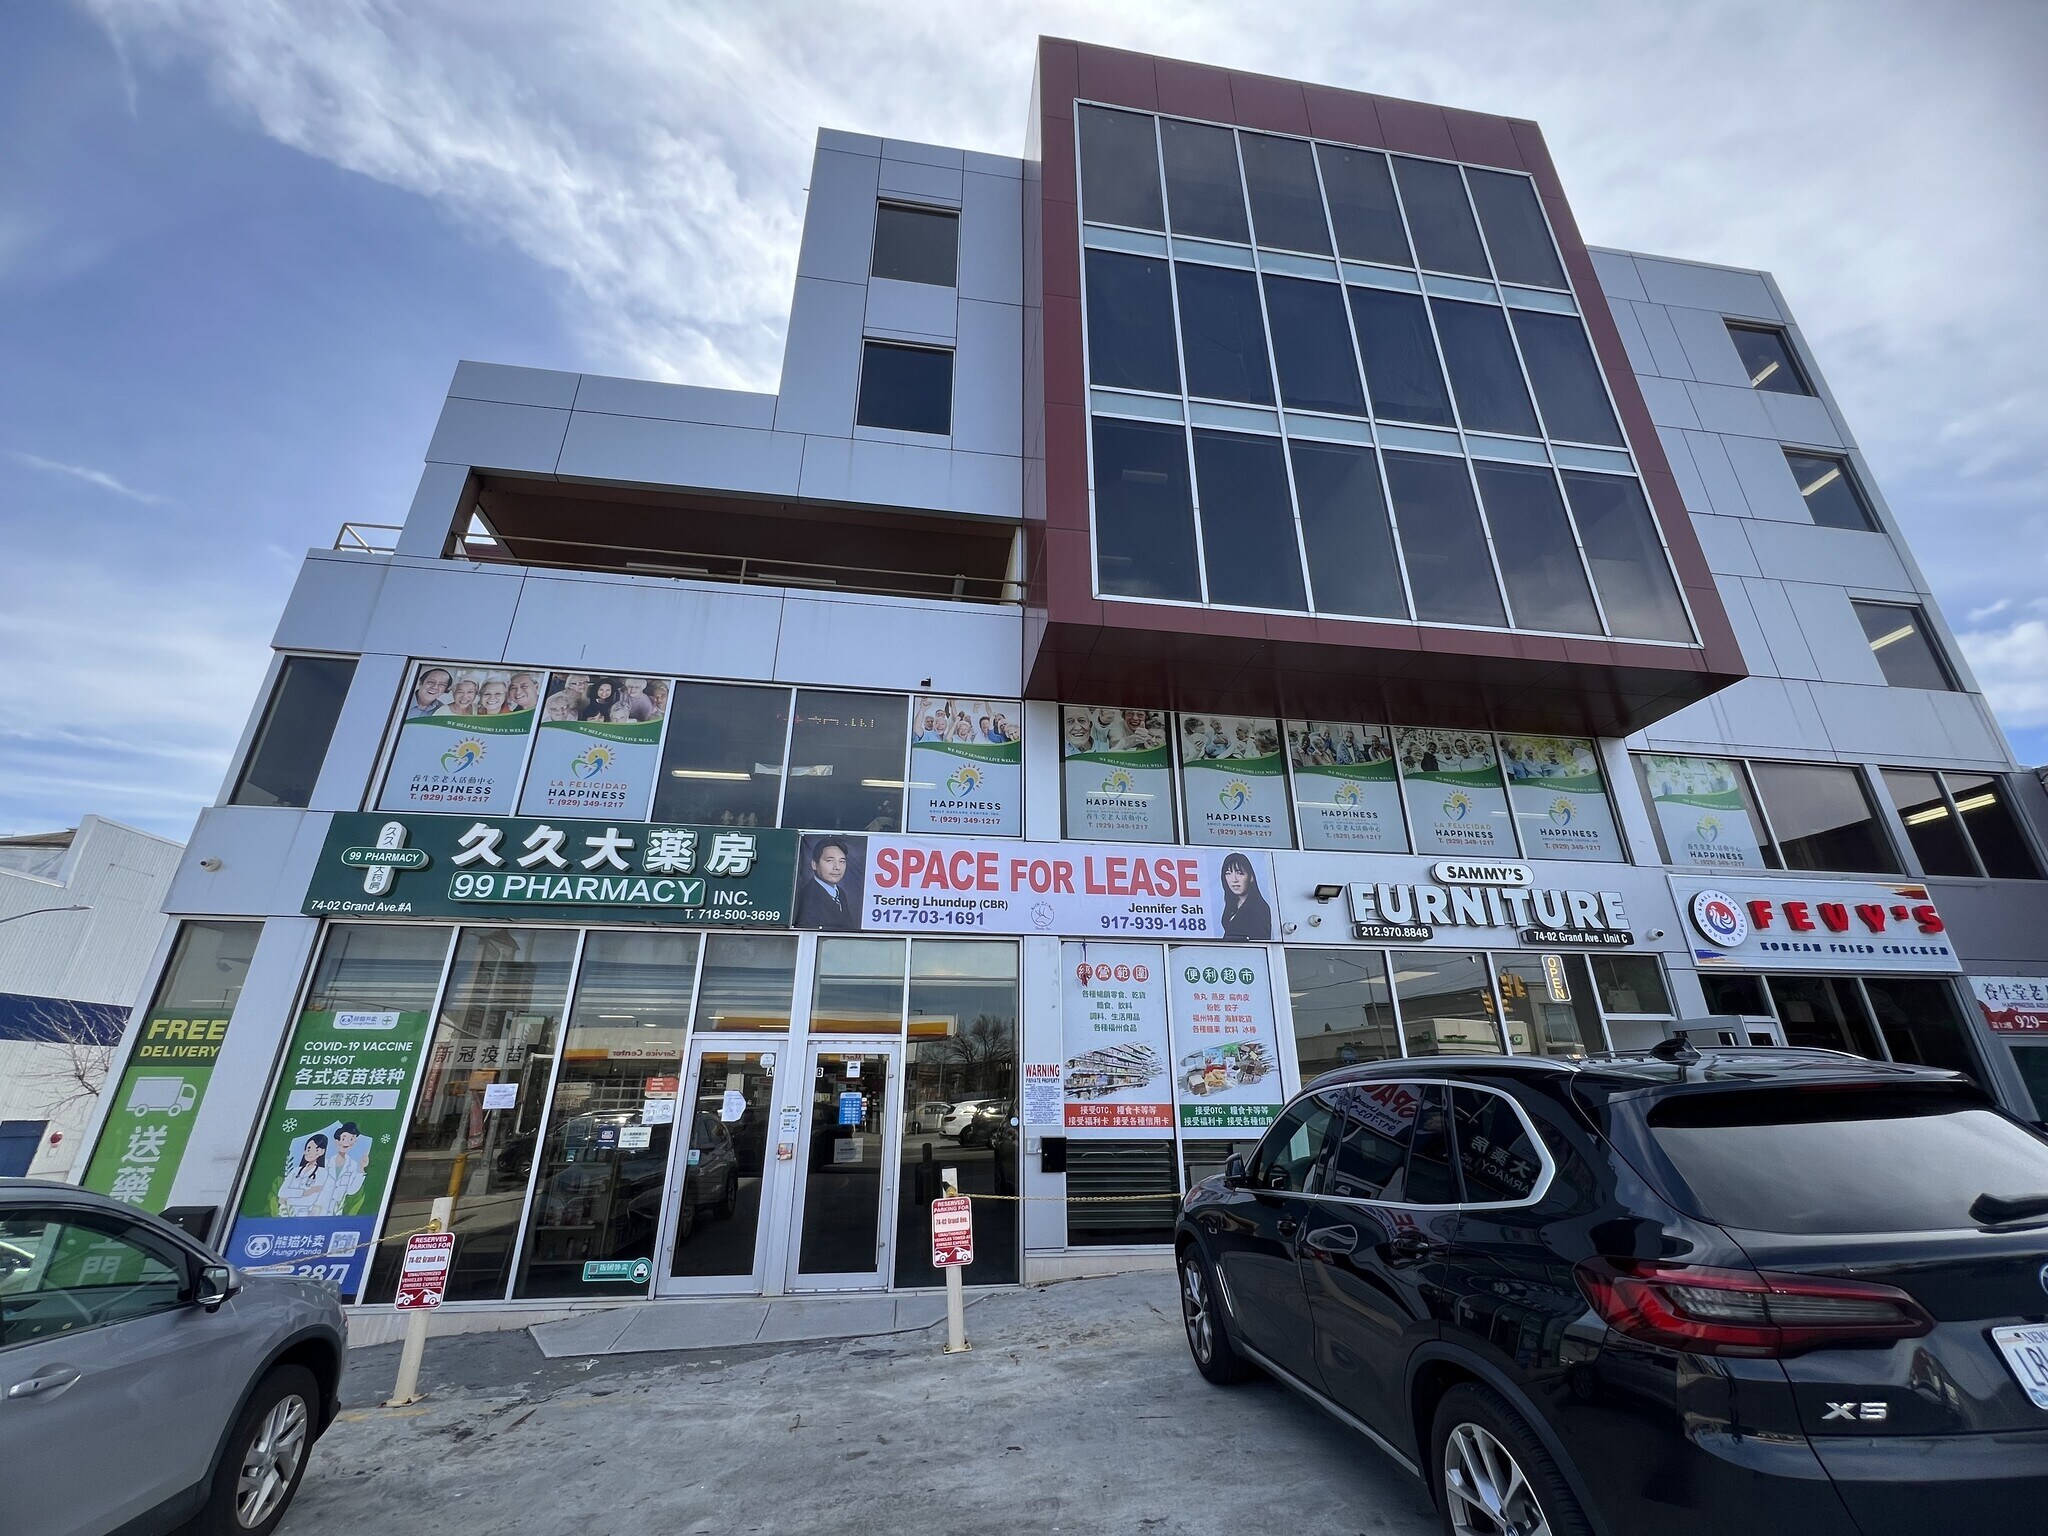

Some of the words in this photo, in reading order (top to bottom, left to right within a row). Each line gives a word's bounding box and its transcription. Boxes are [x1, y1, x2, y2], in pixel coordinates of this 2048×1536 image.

[410, 784, 492, 795] HAPPINESS
[569, 781, 627, 790] FELICIDAD
[447, 794, 490, 802] 349-1217
[548, 789, 626, 800] HAPPINESS
[558, 799, 580, 807] (929)
[583, 800, 624, 808] 349-1217
[930, 800, 1001, 811] HAPPINESS
[1086, 798, 1147, 808] HAPPINESS
[940, 816, 961, 824] (929)
[964, 817, 1000, 825] 349-1217
[1206, 813, 1271, 823] HAPPINESS
[1321, 810, 1378, 819] HAPPINESS
[1239, 829, 1272, 837] 349-1217
[1436, 829, 1494, 839] HAPPINESS
[1540, 829, 1598, 838] HAPPINESS
[451, 822, 757, 874] 久久大藥房
[349, 851, 362, 861] 99
[365, 852, 420, 863] PHARMACY
[1690, 851, 1743, 861] HAPPINESS
[874, 848, 1000, 892] SPACE
[1010, 859, 1075, 894] FOR
[1084, 856, 1200, 898] LEASE
[1446, 866, 1524, 881] SAMMY'S
[454, 874, 495, 898] 99
[502, 875, 701, 903] PHARMACY
[713, 890, 754, 906] INC.
[873, 895, 919, 909] Tsering
[923, 896, 977, 911] Lhundup
[979, 898, 1009, 911] (CBR)
[311, 900, 340, 911] 74-02
[342, 901, 375, 912] Grand
[375, 901, 413, 913] Ave.#A
[1128, 903, 1178, 915] Jennifer
[1180, 904, 1204, 915] Sah
[1347, 882, 1630, 929] FURNITURE
[684, 909, 694, 920] T.
[698, 909, 781, 921] 718-500-3699
[872, 908, 984, 926] 917-703-1691
[1100, 916, 1207, 931] 917-939-1488
[1361, 926, 1429, 937] 212.970.8848
[1534, 931, 1558, 941] 74-02
[1558, 932, 1583, 942] Grand
[1584, 933, 1602, 943] Ave.
[1603, 934, 1620, 943] Unit
[1621, 934, 1628, 944] C
[1760, 942, 1822, 952] KOREAN
[1830, 944, 1874, 953] FRIED
[1883, 945, 1949, 956] CHICKEN
[1186, 968, 1253, 982] 便利超市
[1547, 957, 1565, 999] OPEN
[1983, 983, 2048, 1000] 養生堂老
[147, 1019, 230, 1041] FREE
[139, 1045, 221, 1058] DELIVERY
[304, 1041, 361, 1051] COVID-19
[362, 1041, 414, 1051] VACCINE
[299, 1055, 322, 1065] FLU
[323, 1055, 356, 1065] SHOT
[433, 1045, 525, 1064] 新冠疫苗
[295, 1067, 406, 1086] 各式疫苗接种
[767, 1068, 773, 1076] A
[816, 1068, 823, 1077] B
[1026, 1064, 1060, 1077] WARNING
[312, 1093, 374, 1107] 无需预约
[1068, 1116, 1110, 1126] 接受福利卡
[1113, 1117, 1170, 1127] 接受各種信用卡
[274, 1235, 326, 1249] 熊猫外卖
[271, 1248, 322, 1258] HungryPanda
[1822, 1402, 1887, 1420] X5
